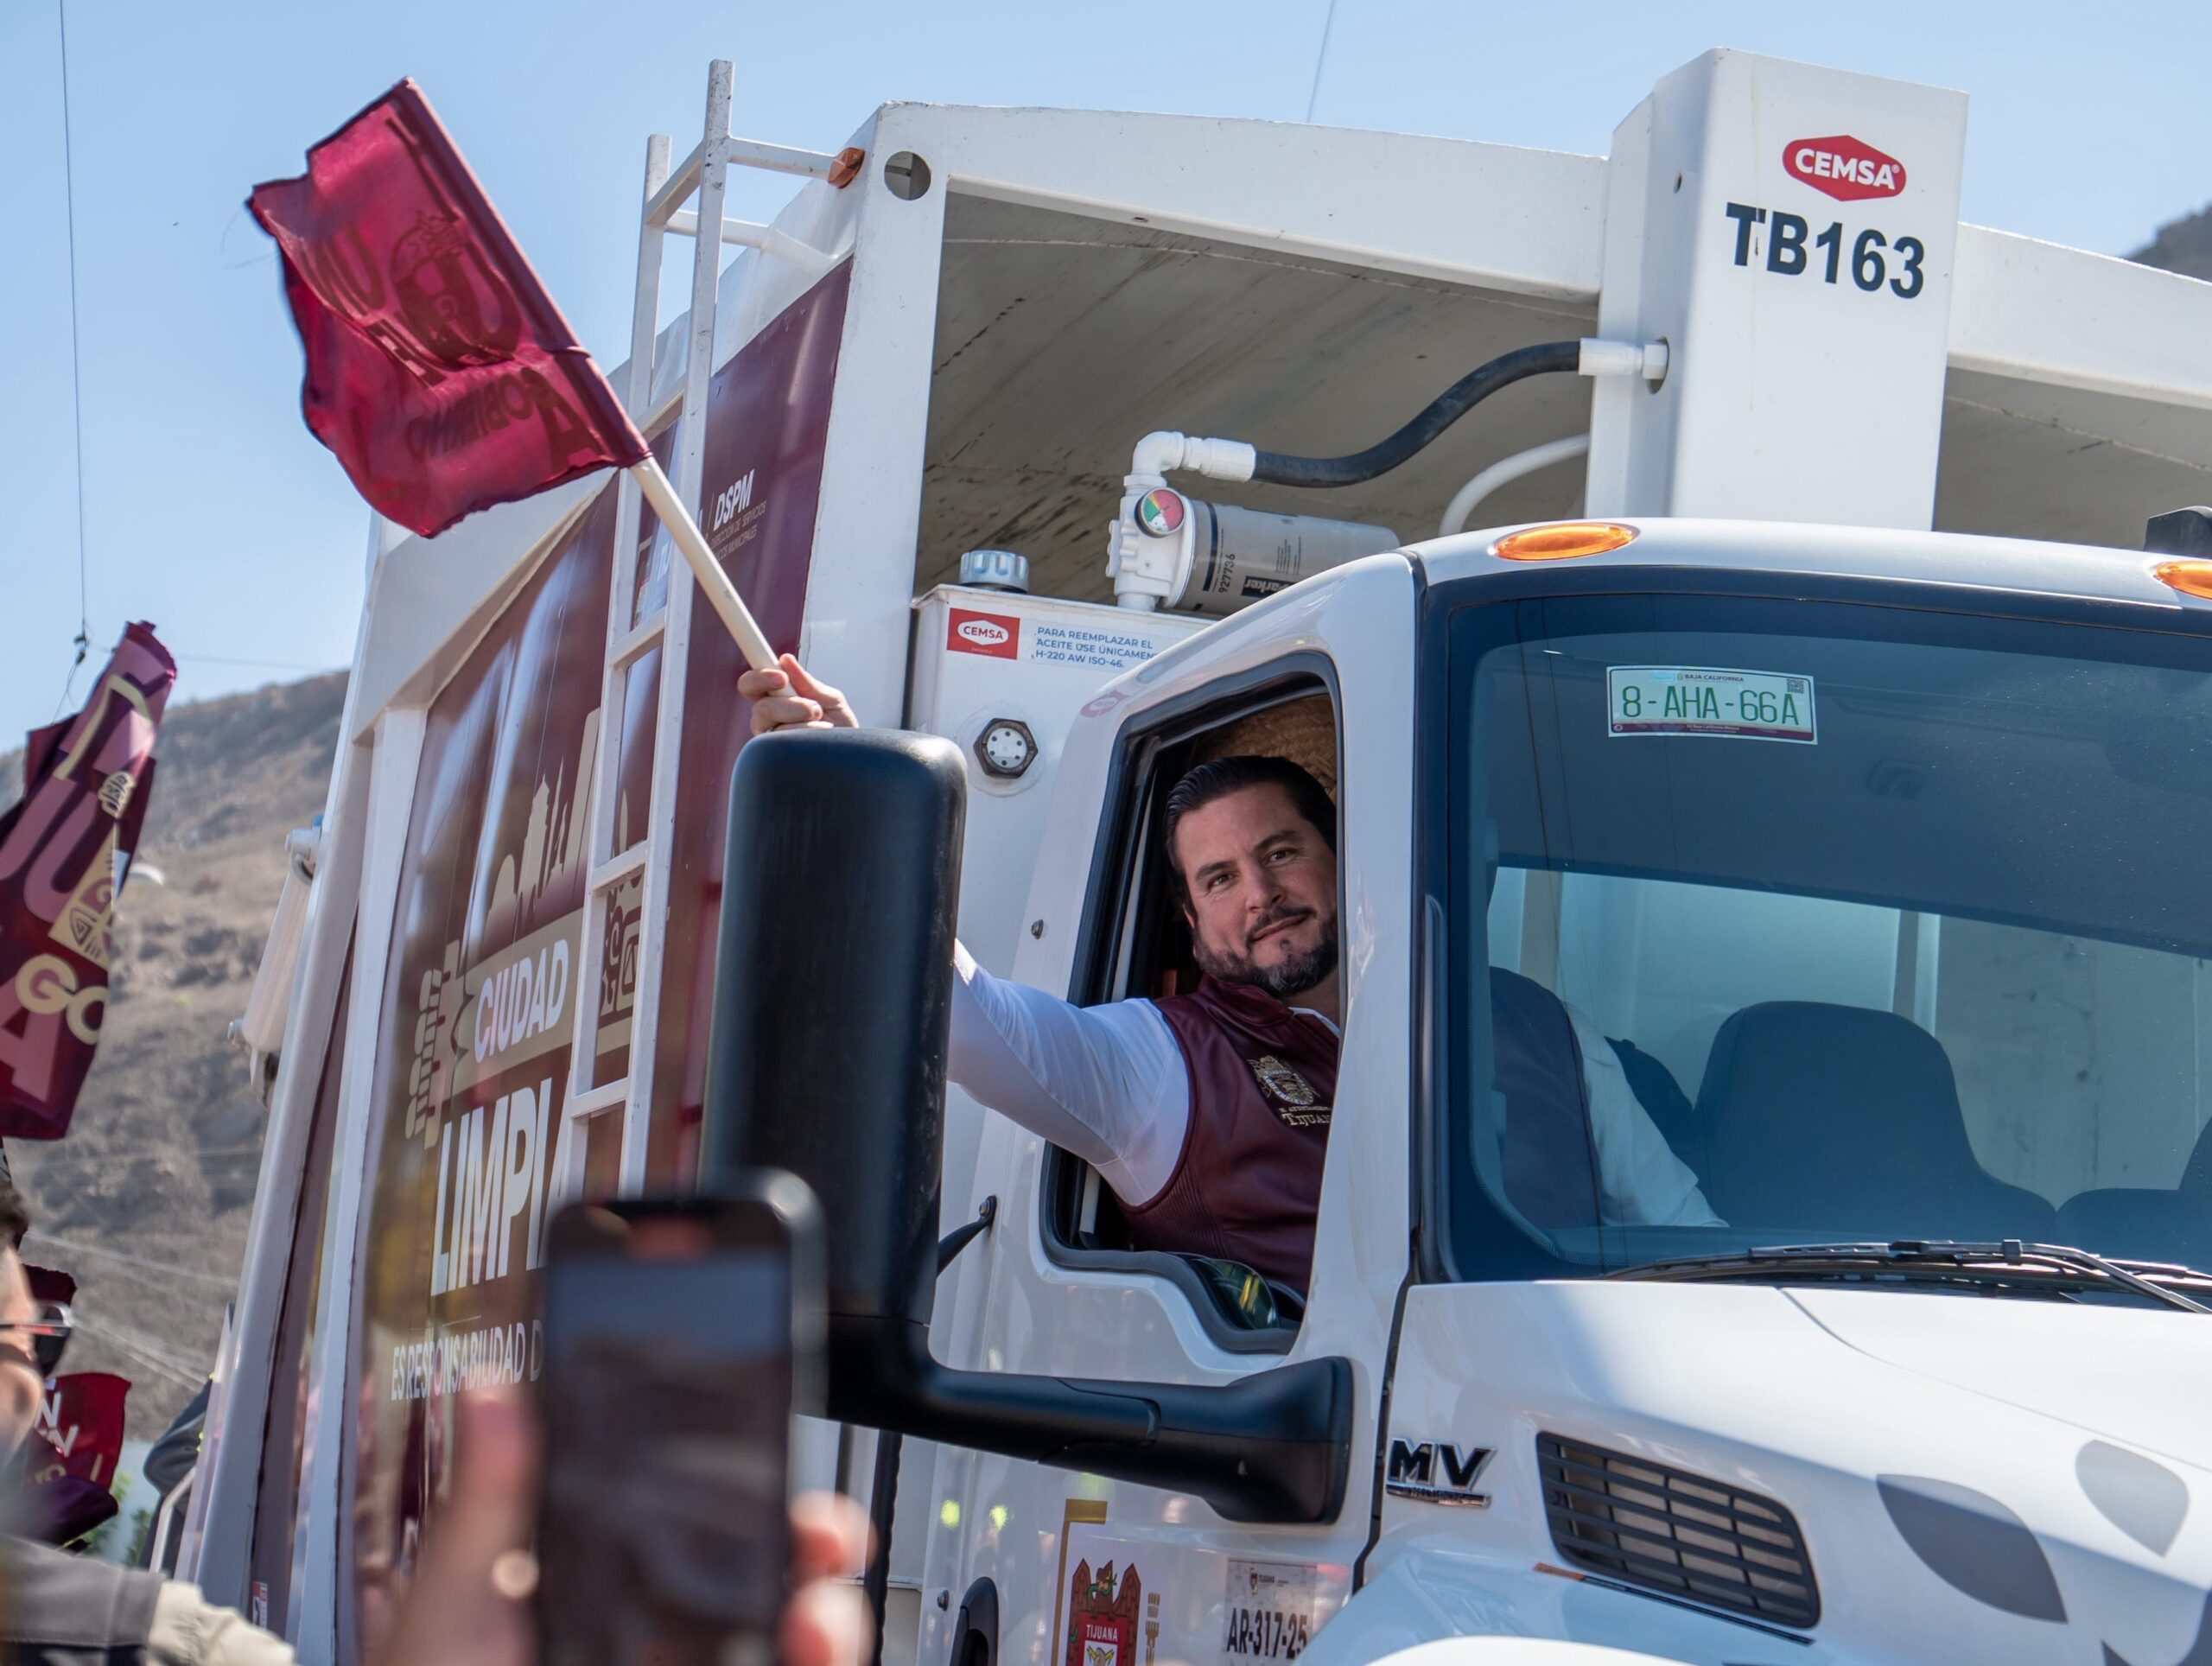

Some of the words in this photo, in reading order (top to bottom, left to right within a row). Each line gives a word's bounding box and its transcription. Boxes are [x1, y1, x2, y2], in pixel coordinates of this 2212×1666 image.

[1795, 148, 1896, 190] CEMSA
[1726, 201, 1925, 299] TB163
[713, 468, 755, 532] DSPM
[1218, 553, 1236, 594] 927736
[1244, 578, 1291, 594] arker
[963, 625, 1005, 640] CEMSA
[1036, 639, 1073, 650] ACEITE
[1075, 642, 1096, 652] USE
[1098, 644, 1157, 659] ÚNICAMEN
[1037, 626, 1066, 638] PARA
[1068, 631, 1139, 646] REEMPLAZAR
[1140, 639, 1154, 649] EL
[1035, 649, 1065, 660] H-220
[1067, 653, 1086, 663] AW
[1622, 685, 1800, 725] 8-AHA-66A
[474, 938, 569, 1064] CIUDAD
[391, 1345, 406, 1402] ES
[406, 1321, 526, 1400] RESPONSABILIDAD
[530, 1319, 544, 1383] D
[1387, 1437, 1498, 1492] MV
[1086, 1624, 1118, 1642] TIJUANA
[1226, 1607, 1308, 1661] AR-317-25
